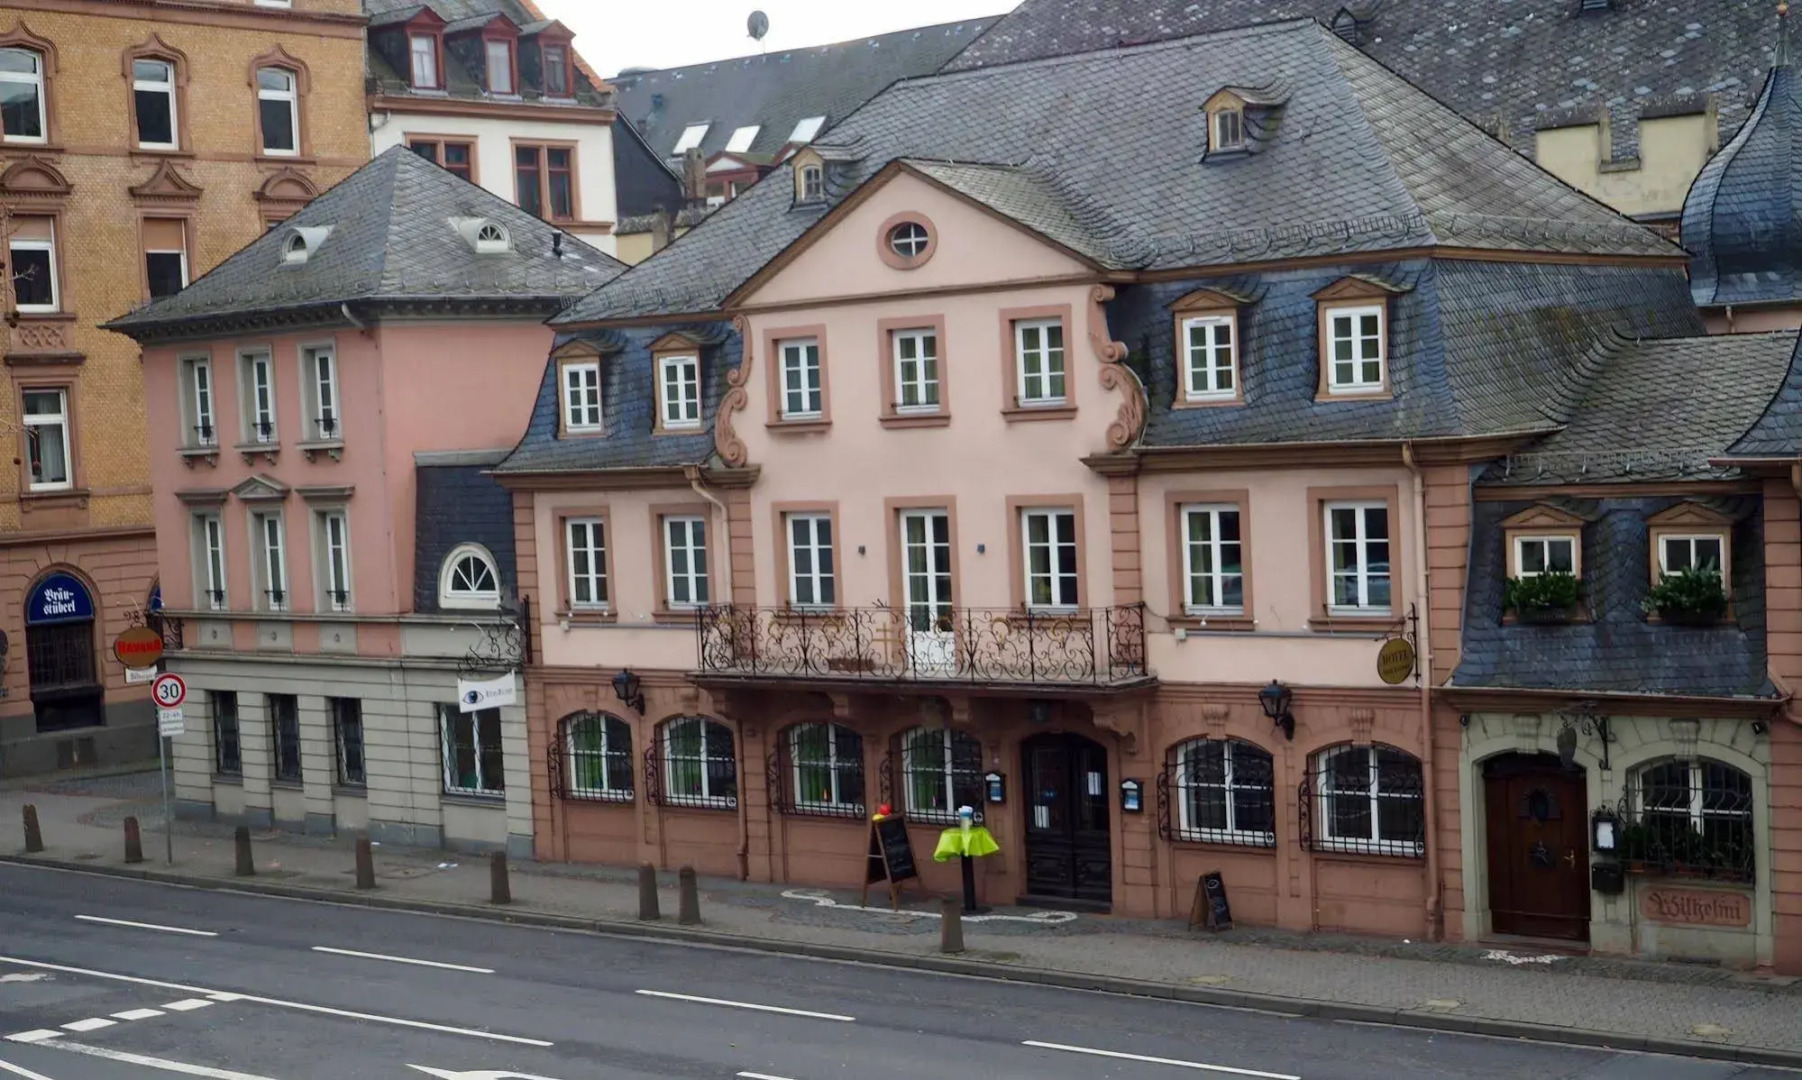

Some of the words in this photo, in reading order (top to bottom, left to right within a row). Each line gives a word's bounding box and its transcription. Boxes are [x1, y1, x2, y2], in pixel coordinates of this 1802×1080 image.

[44, 588, 74, 602] Bräu-
[43, 600, 76, 615] stüberl
[160, 683, 179, 700] 30
